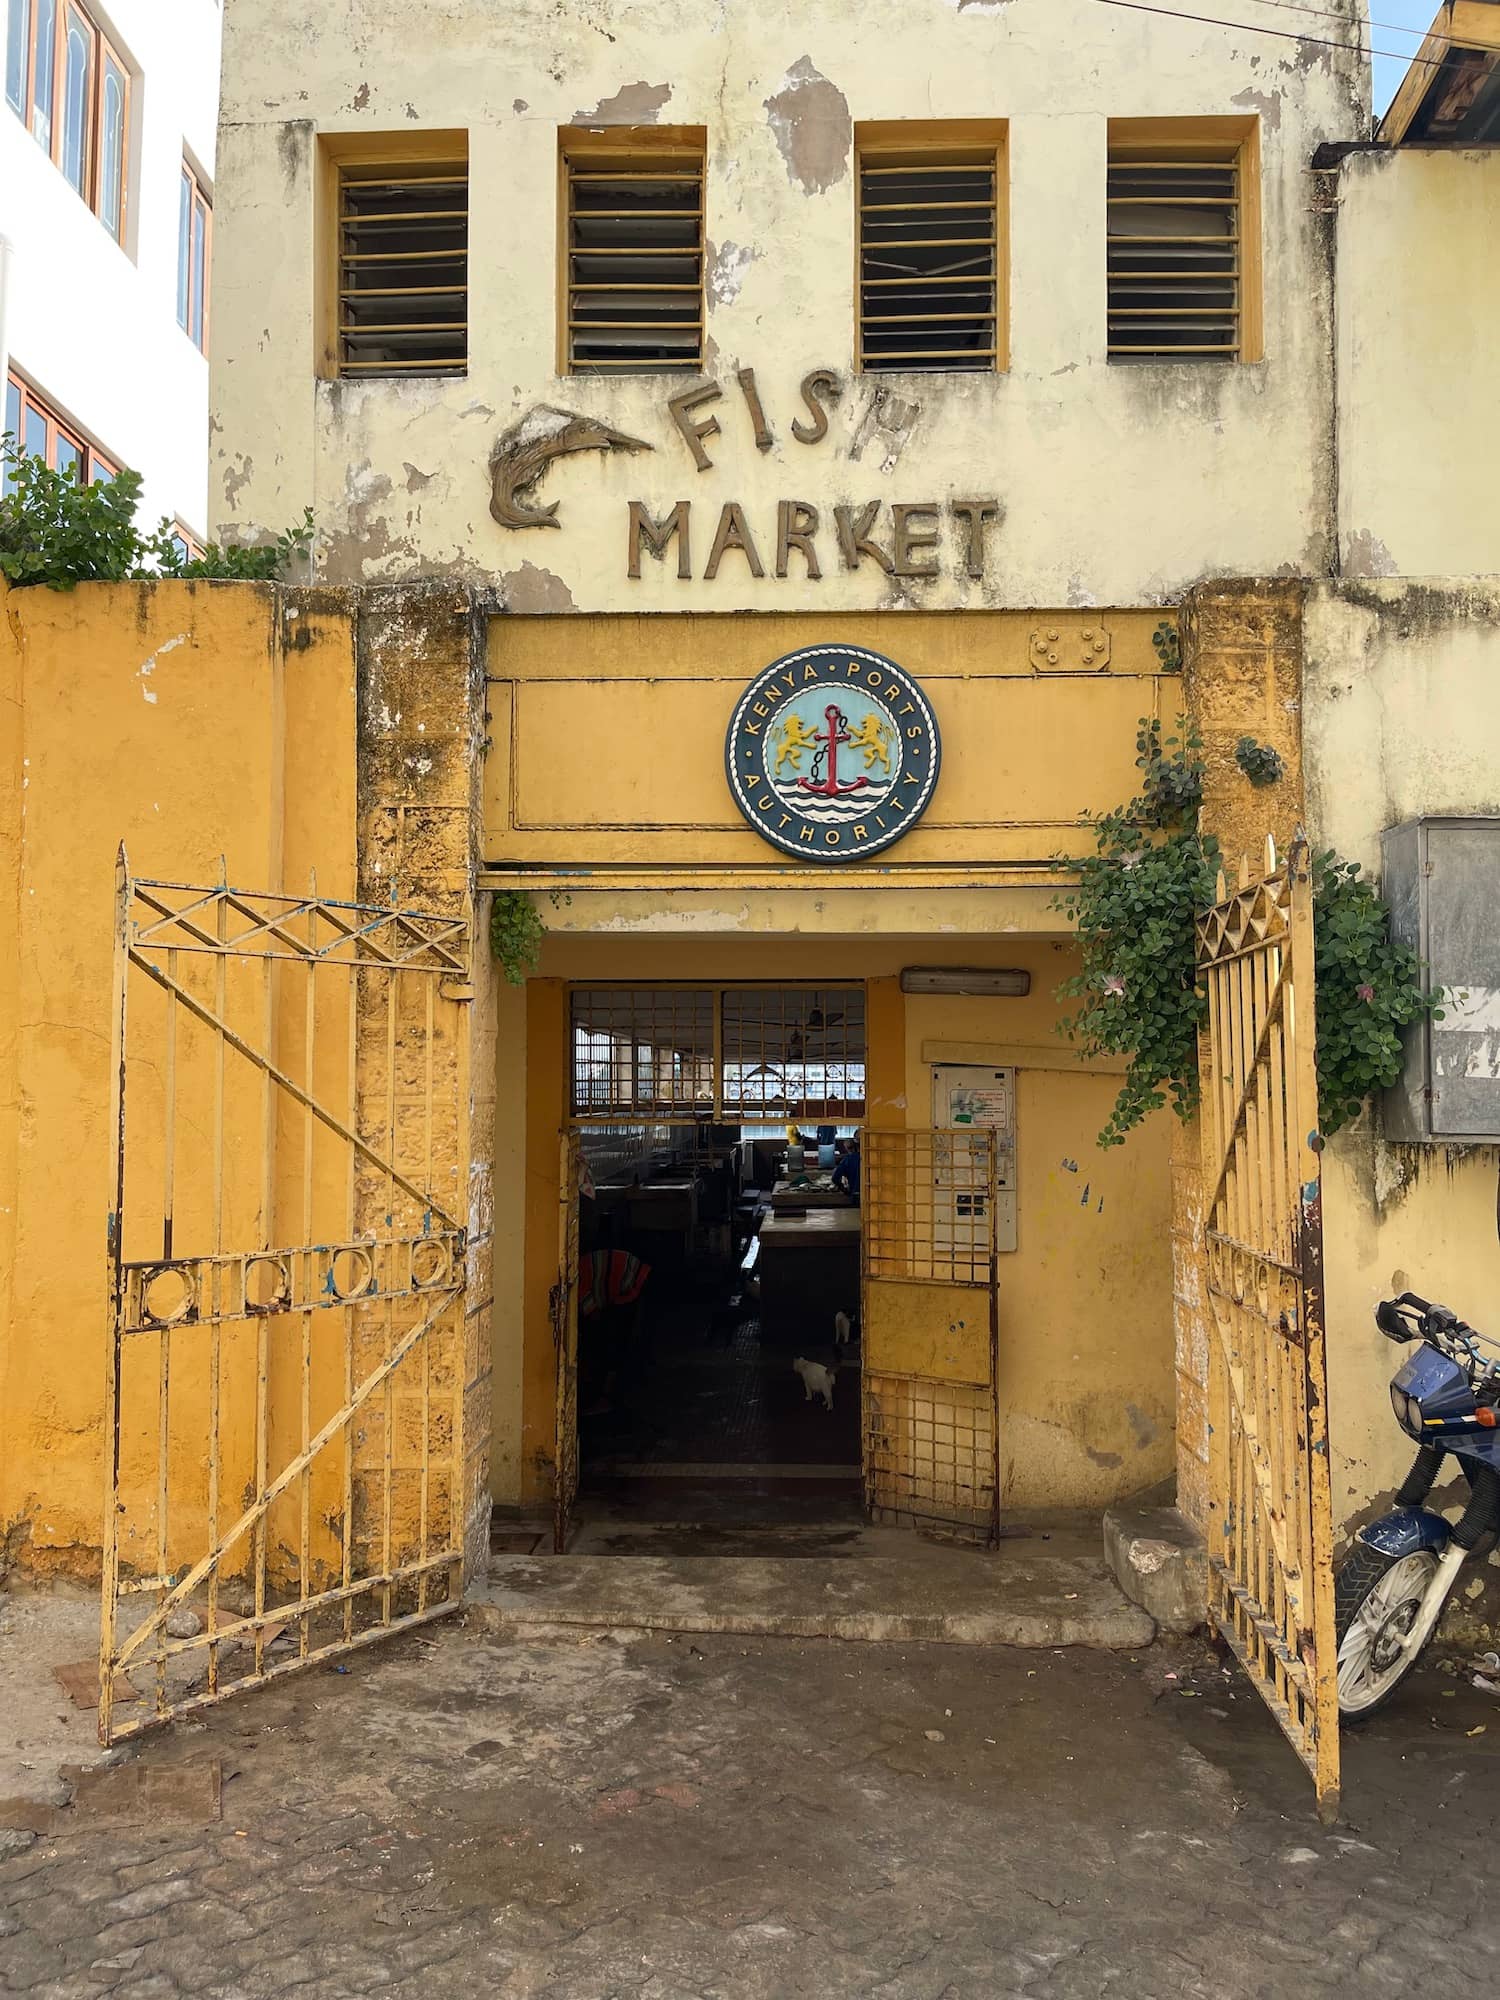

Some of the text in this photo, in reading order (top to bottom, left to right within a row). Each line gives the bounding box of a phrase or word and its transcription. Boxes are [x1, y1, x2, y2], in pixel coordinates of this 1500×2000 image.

[627, 499, 998, 580] MARKET
[745, 662, 922, 739] KENYA PORTS
[743, 771, 920, 845] AUTHORITY
